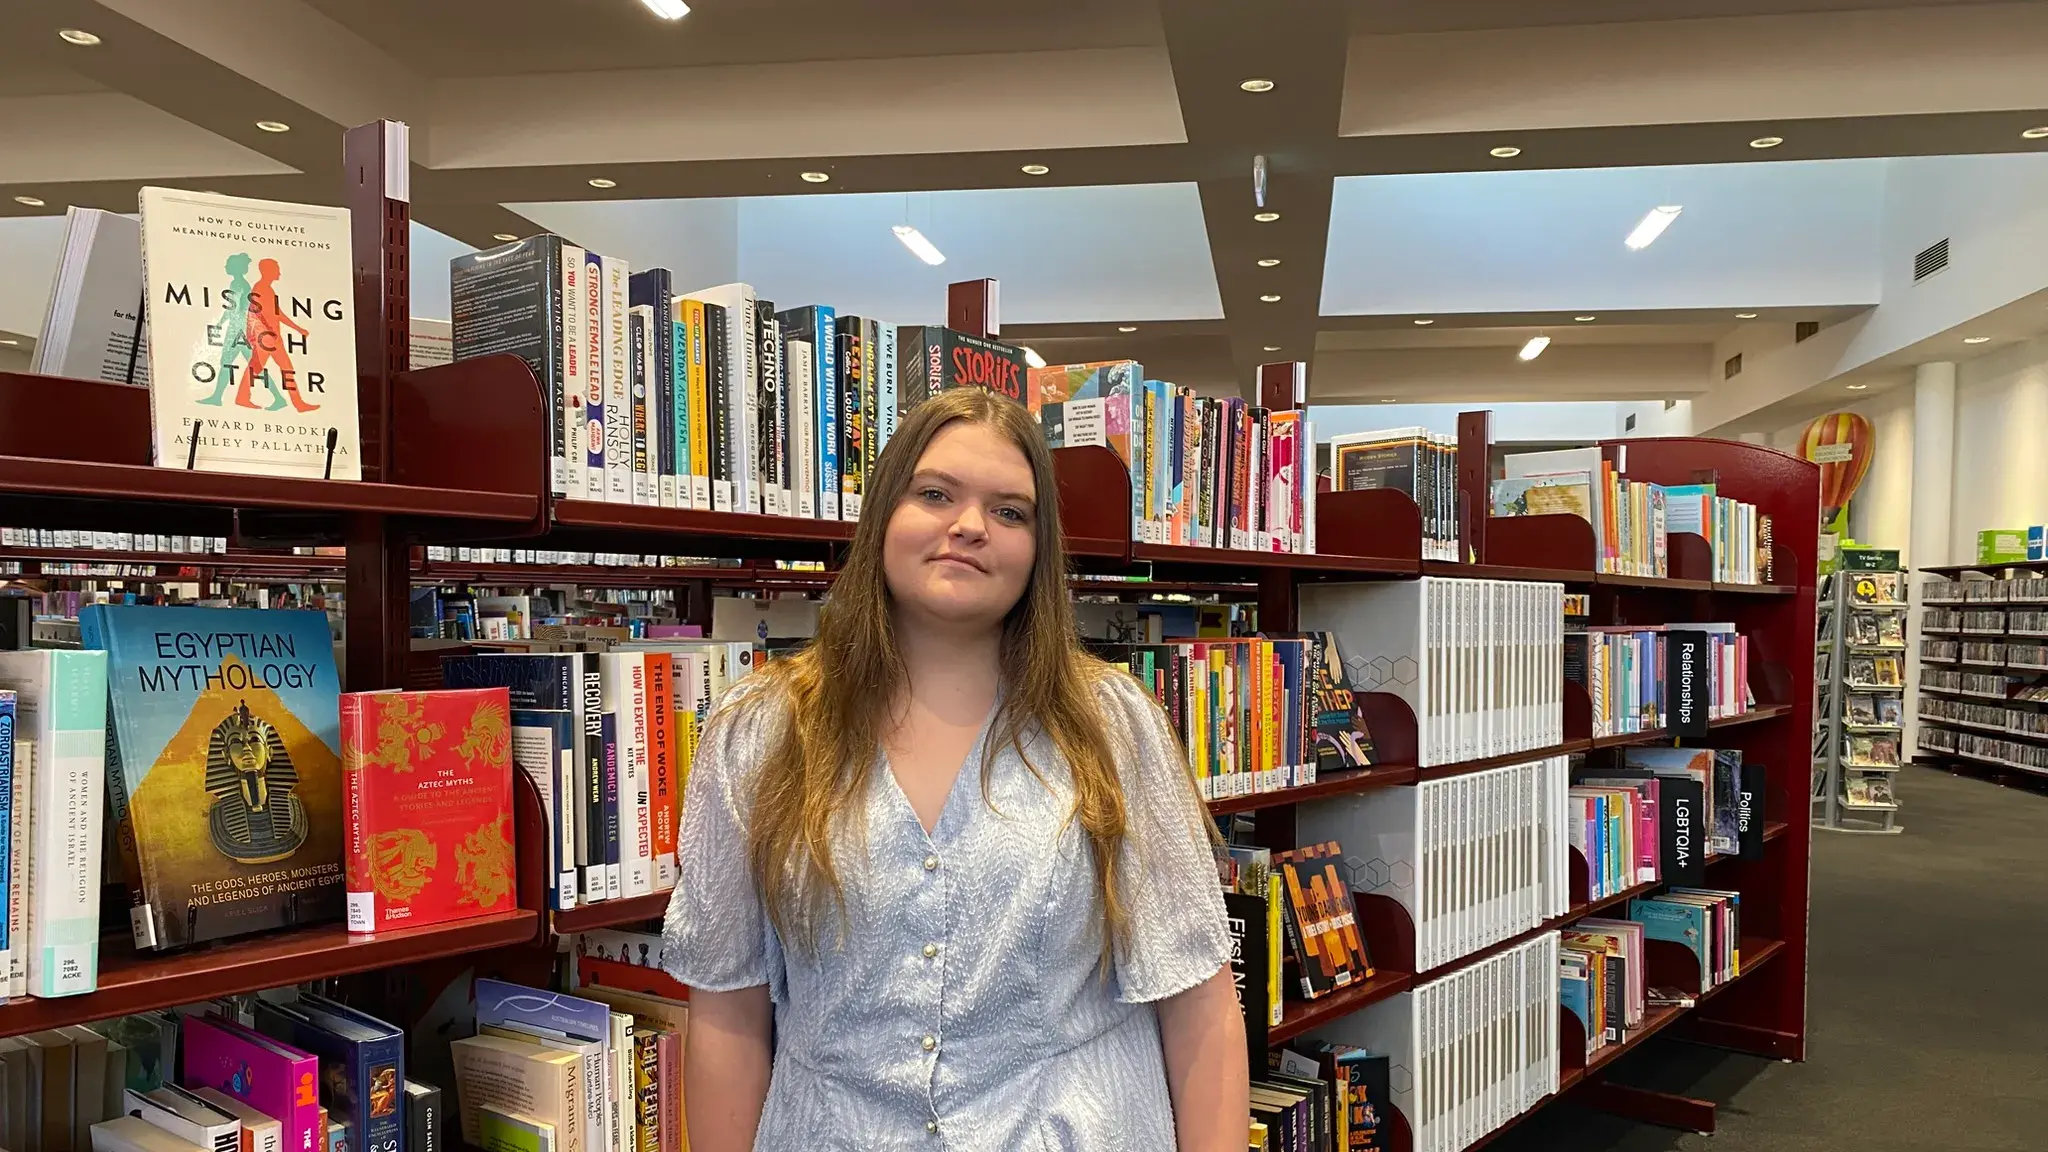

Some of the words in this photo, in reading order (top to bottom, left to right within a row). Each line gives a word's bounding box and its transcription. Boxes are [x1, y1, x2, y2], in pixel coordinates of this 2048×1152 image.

[172, 226, 247, 242] MEANINGFUL
[251, 235, 331, 250] CONNECTIONS
[198, 216, 223, 225] HOW
[229, 219, 242, 227] TO
[247, 221, 306, 234] CULTIVATE
[567, 257, 575, 268] SO
[567, 271, 576, 287] YOU
[588, 267, 599, 317] STRONG
[114, 309, 124, 319] for
[125, 312, 137, 322] the
[165, 282, 343, 321] MISSING
[568, 289, 576, 313] WANT
[568, 313, 576, 323] TO
[568, 325, 576, 337] BE
[612, 291, 623, 356] LEADING
[824, 314, 833, 323] A
[207, 325, 308, 355] EACH
[555, 335, 562, 348] IN
[589, 319, 600, 367] FEMALE
[664, 338, 669, 350] ON
[825, 325, 834, 365] WORLD
[886, 329, 893, 340] IF
[569, 344, 577, 377] LEADER
[677, 326, 687, 382] EVERYDAY
[763, 318, 776, 392] TECHNO
[850, 336, 861, 379] LEAD
[886, 343, 893, 360] WE
[929, 344, 943, 390] STORIES
[191, 361, 325, 394] OTHER
[590, 370, 600, 401] LEAD
[613, 359, 624, 400] EDGE
[825, 367, 835, 419] WITHOUT
[556, 382, 564, 412] FACE
[264, 423, 327, 437] BRODKI
[557, 418, 563, 431] OF
[634, 405, 646, 435] WHERE
[678, 385, 688, 444] ACTIVISM
[174, 434, 243, 448] ASHLEY
[251, 440, 349, 455] PALLATHA
[619, 415, 630, 469] HOLLY
[635, 437, 646, 449] TO
[826, 422, 836, 456] WORK
[852, 412, 862, 450] WAY
[635, 451, 646, 474] BEGI
[155, 632, 296, 659] EGYPTIAN
[138, 663, 317, 693] MYTHOLOGY
[632, 665, 643, 691] HOW
[654, 663, 663, 692] THE
[1681, 642, 1695, 725] Relationships
[584, 672, 602, 737] RECOVERY
[634, 692, 643, 705] TO
[655, 695, 664, 726] END
[634, 706, 645, 744] EXPECT
[656, 730, 665, 749] OF
[0, 722, 11, 812] ZOROASTRIANISM
[14, 759, 22, 780] THE
[635, 745, 646, 766] THE
[69, 770, 77, 784] OF
[80, 770, 89, 807] WOMEN
[350, 772, 358, 790] THE
[417, 781, 444, 790] AZTEC
[446, 778, 474, 788] MYTHS
[437, 769, 455, 777] THE
[657, 752, 667, 797] WOKE
[13, 784, 22, 827] BEAUTY
[68, 788, 77, 832] ANCIENT
[111, 770, 133, 853] MYTHOLOGY
[351, 793, 359, 821] AZTEC
[637, 791, 647, 805] UN
[1738, 791, 1752, 833] Politics
[13, 830, 21, 845] OF
[352, 823, 361, 854] MYTHS
[637, 806, 649, 858] EXPECTED
[663, 805, 671, 844] ANDREW
[1676, 798, 1690, 869] LGBTQIA+
[12, 849, 20, 880] WHAT
[67, 835, 77, 868] ISRAEL
[78, 857, 87, 904] RELIGION
[187, 895, 210, 909] AND
[212, 887, 260, 904] LEGENDS
[261, 884, 275, 896] OF
[277, 879, 317, 894] ANCIENT
[318, 873, 345, 887] EGYPT
[191, 884, 213, 895] THE
[214, 878, 247, 893] GODS,
[248, 872, 290, 887] HEROES,
[291, 863, 339, 880] MONSTERS
[10, 884, 20, 933] REMAINS
[1227, 917, 1246, 966] First
[62, 972, 83, 980] ACKE
[593, 1052, 601, 1090] Human
[644, 1046, 658, 1074] THE
[564, 1065, 576, 1134] Migrants
[594, 1092, 602, 1127] Peoples
[644, 1082, 659, 1152] PERENNI
[302, 1128, 313, 1150] THE
